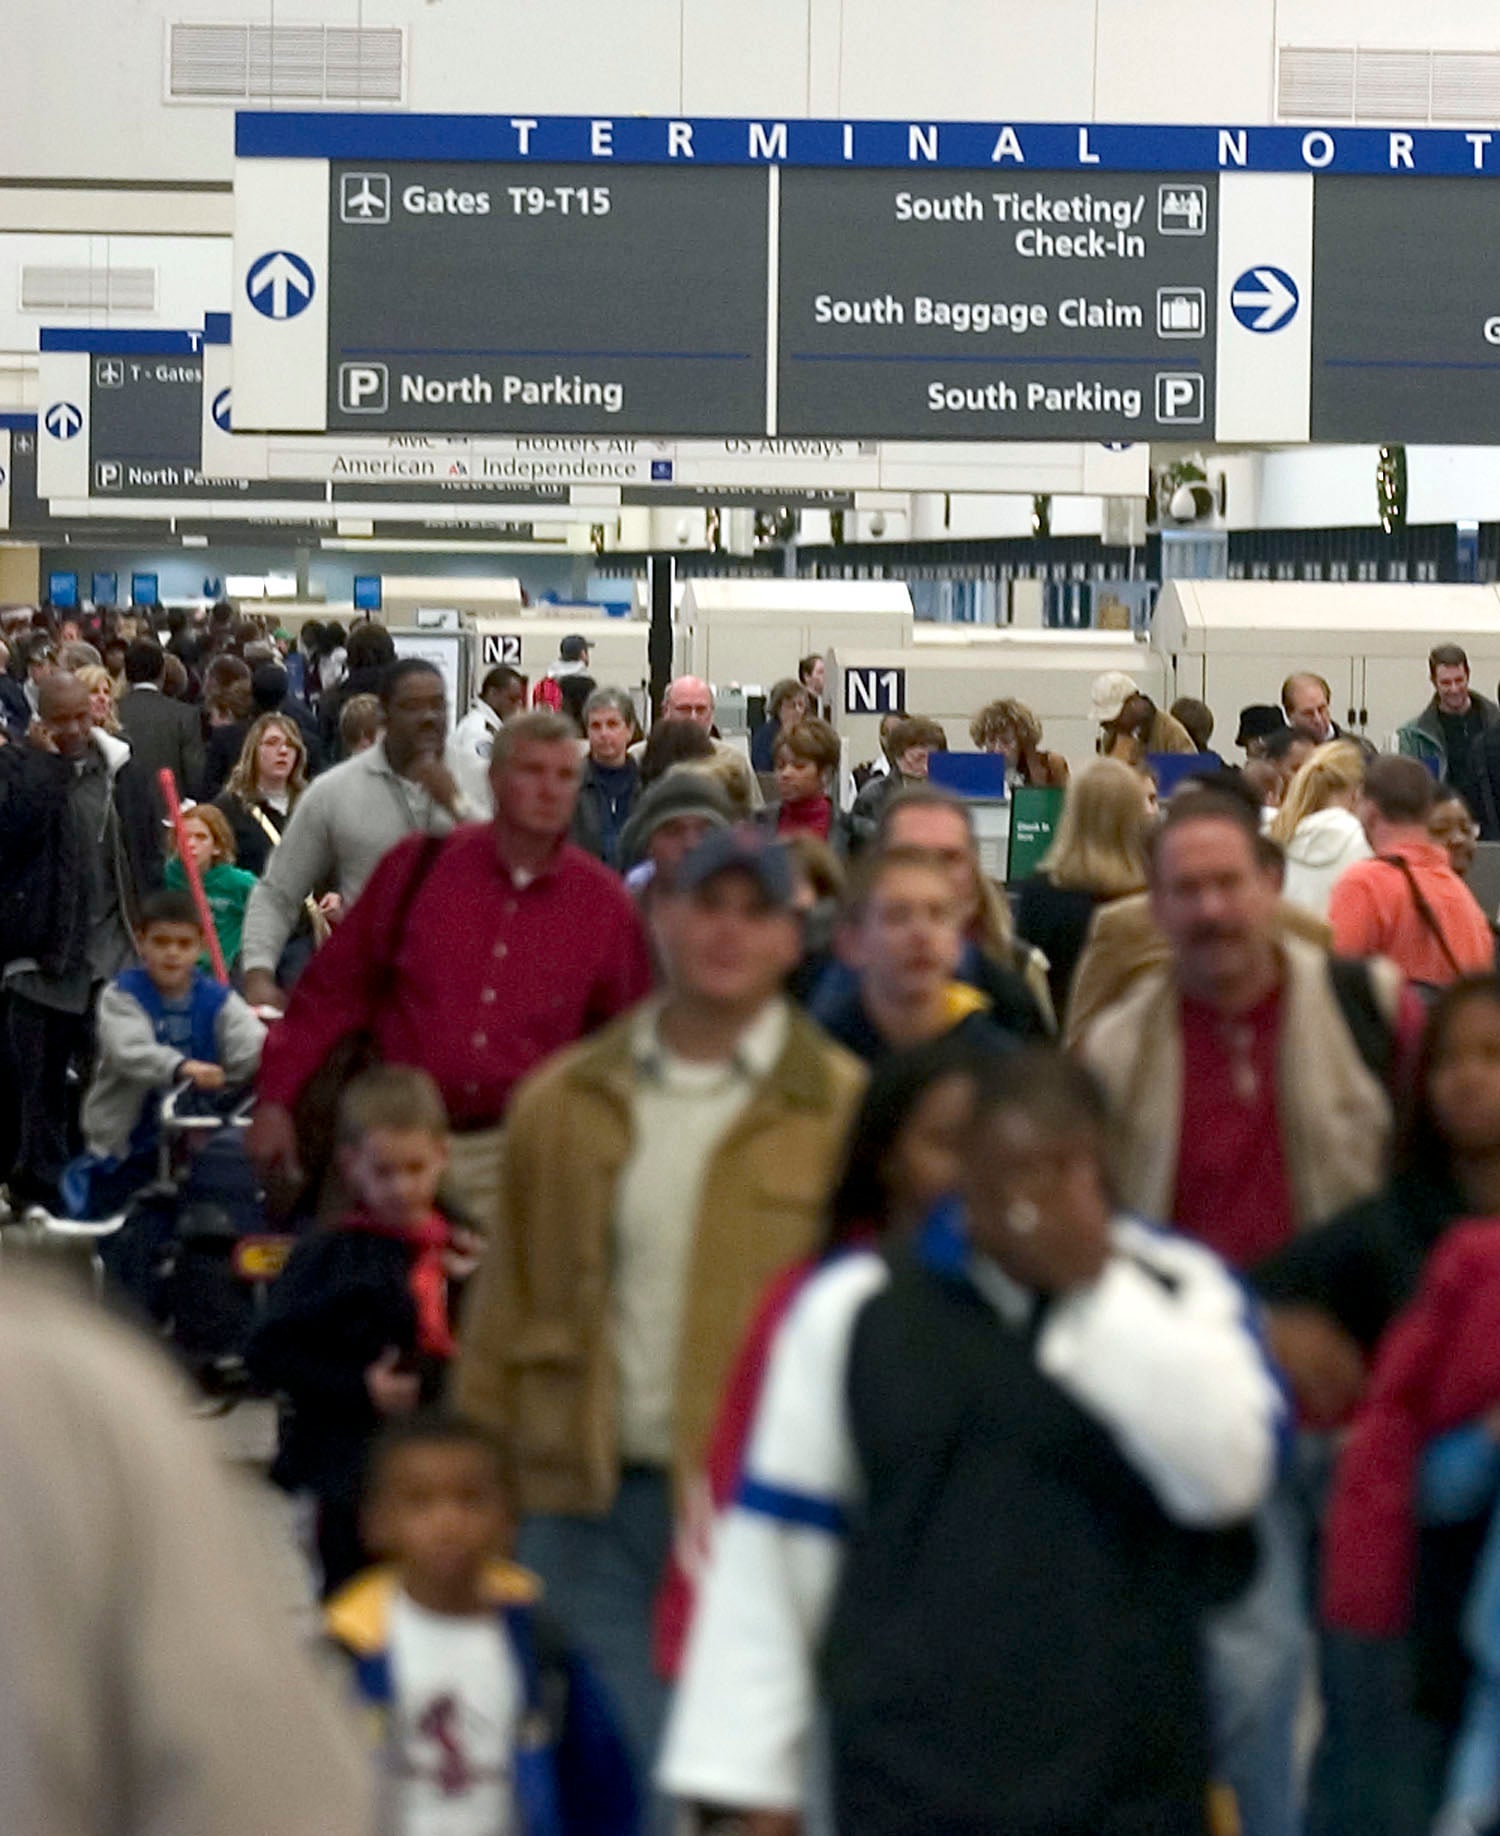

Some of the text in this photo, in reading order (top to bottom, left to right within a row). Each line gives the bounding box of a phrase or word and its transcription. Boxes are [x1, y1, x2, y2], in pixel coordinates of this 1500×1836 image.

[511, 120, 1101, 164] TERMINAL
[402, 185, 610, 215] Gates T9-T15
[895, 191, 1145, 226] South Ticketing/
[1015, 228, 1146, 258] Check-In
[815, 294, 1143, 333] South Baggage Claim
[401, 374, 492, 404] North
[503, 375, 623, 413] Parking
[928, 381, 1017, 410] South
[1027, 382, 1142, 418] Parking
[129, 467, 179, 485] North
[332, 455, 435, 475] American
[483, 456, 637, 482] Independence
[485, 637, 519, 663] N2
[848, 670, 898, 711] N1
